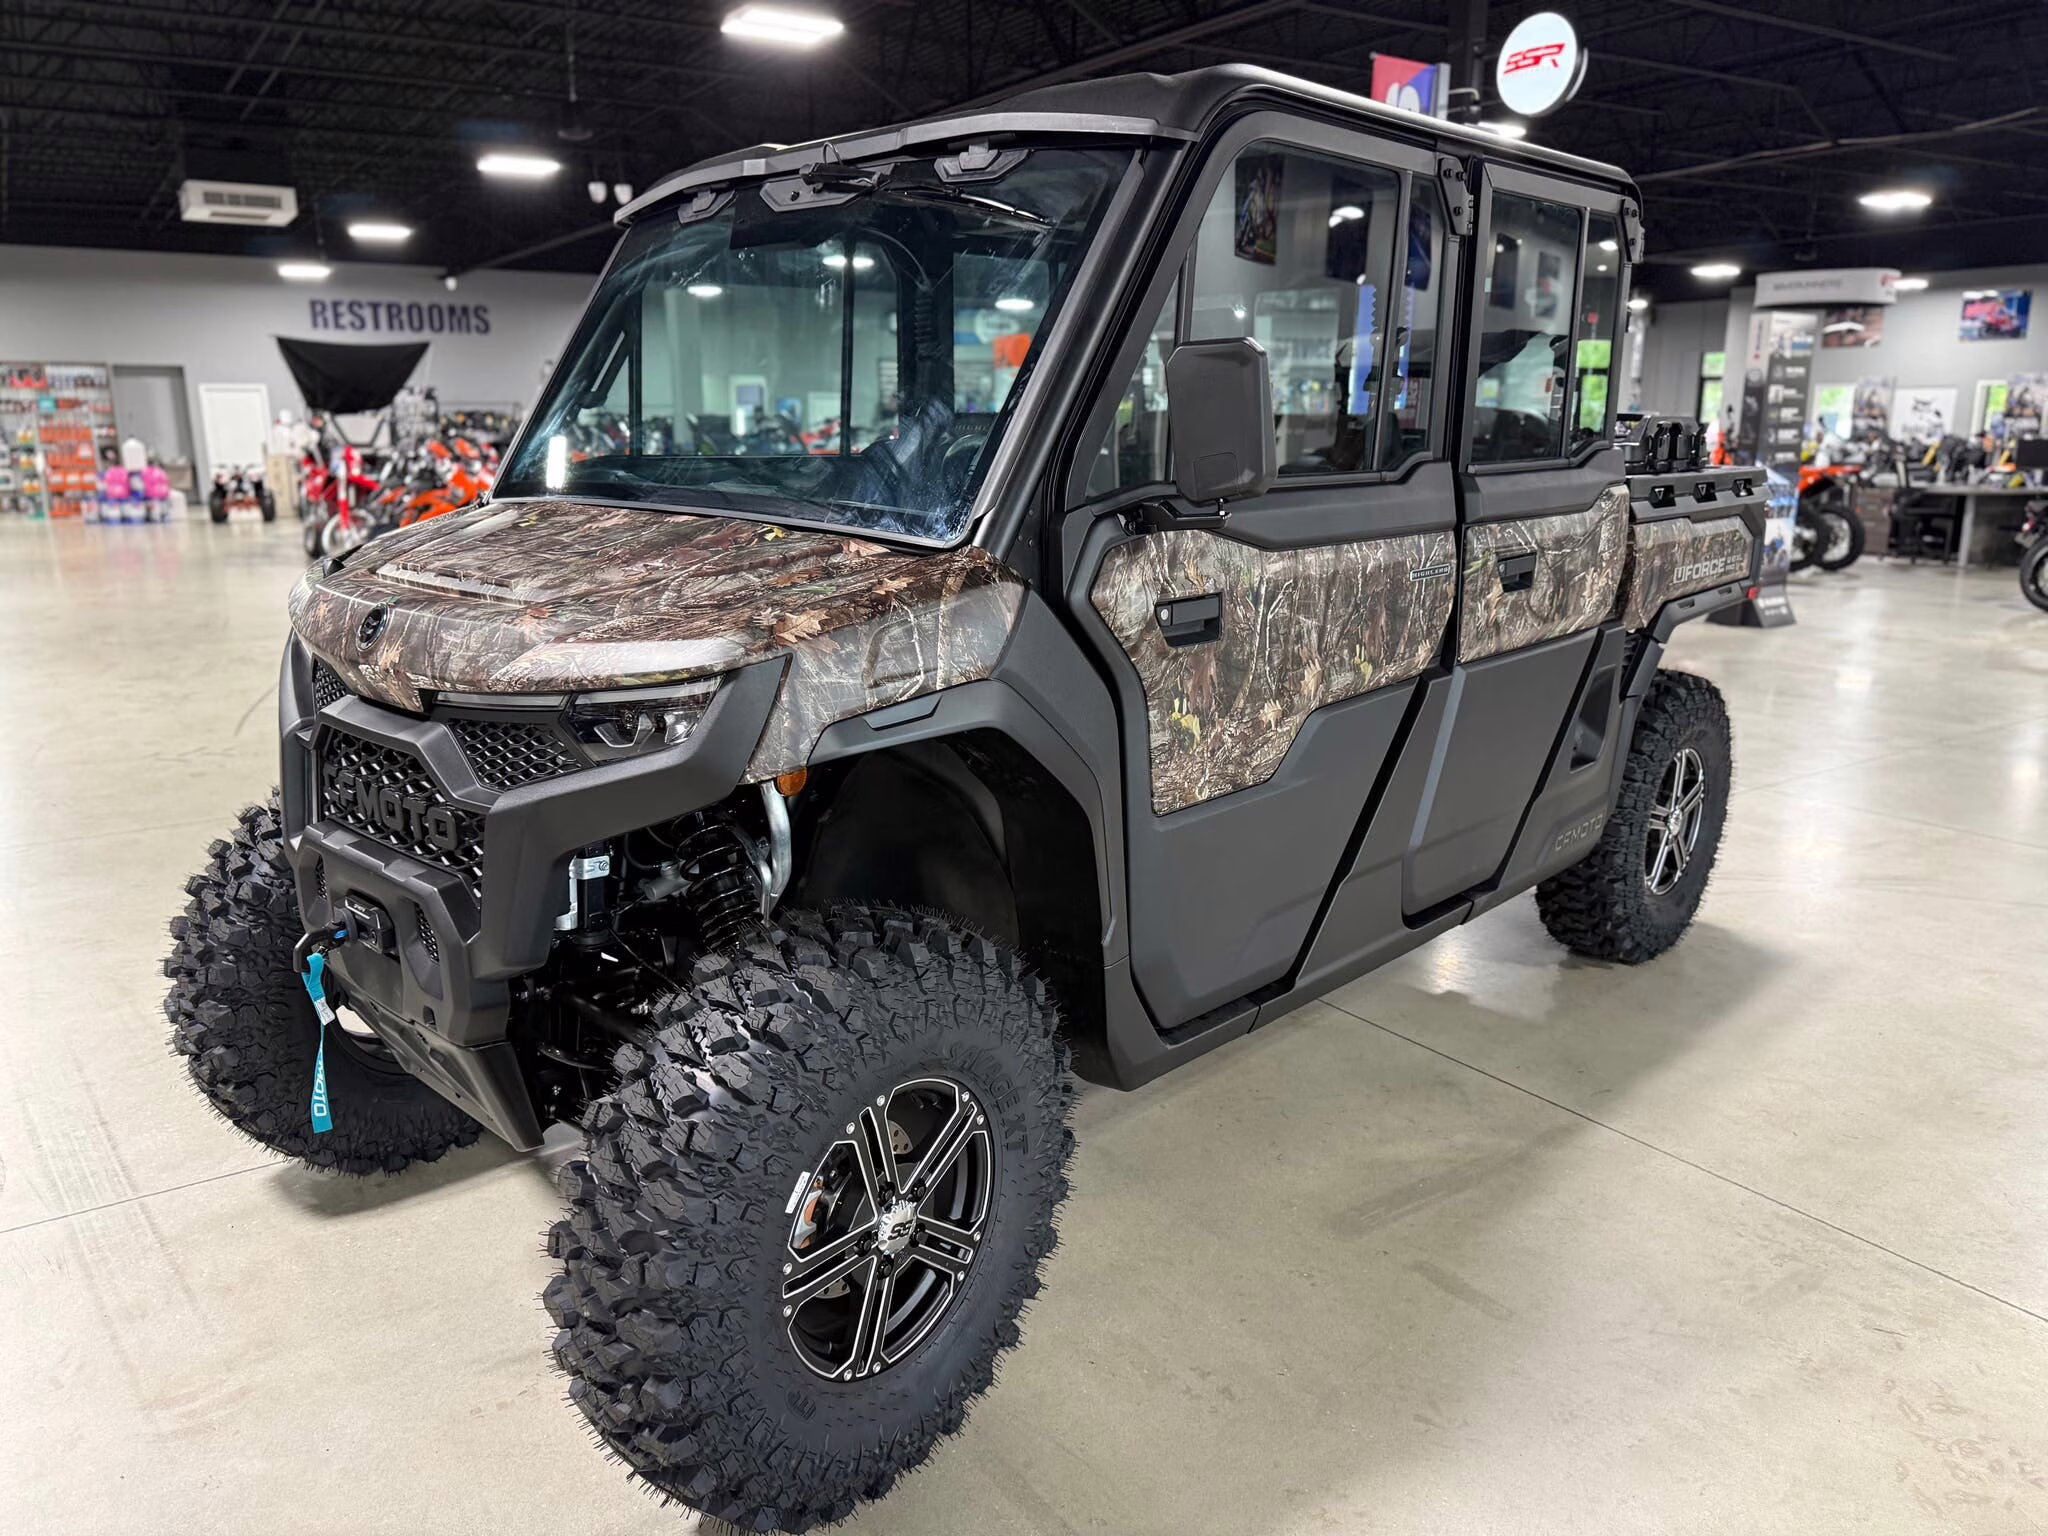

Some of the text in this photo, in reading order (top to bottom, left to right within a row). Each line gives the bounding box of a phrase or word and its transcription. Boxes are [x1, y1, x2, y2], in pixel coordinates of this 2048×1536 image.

[309, 299, 491, 335] RESTROOMS
[1412, 566, 1448, 578] HIGHLAND
[1673, 558, 1726, 583] UFORCE
[323, 762, 458, 850] CFMOTO
[1555, 814, 1603, 851] CFMOTO
